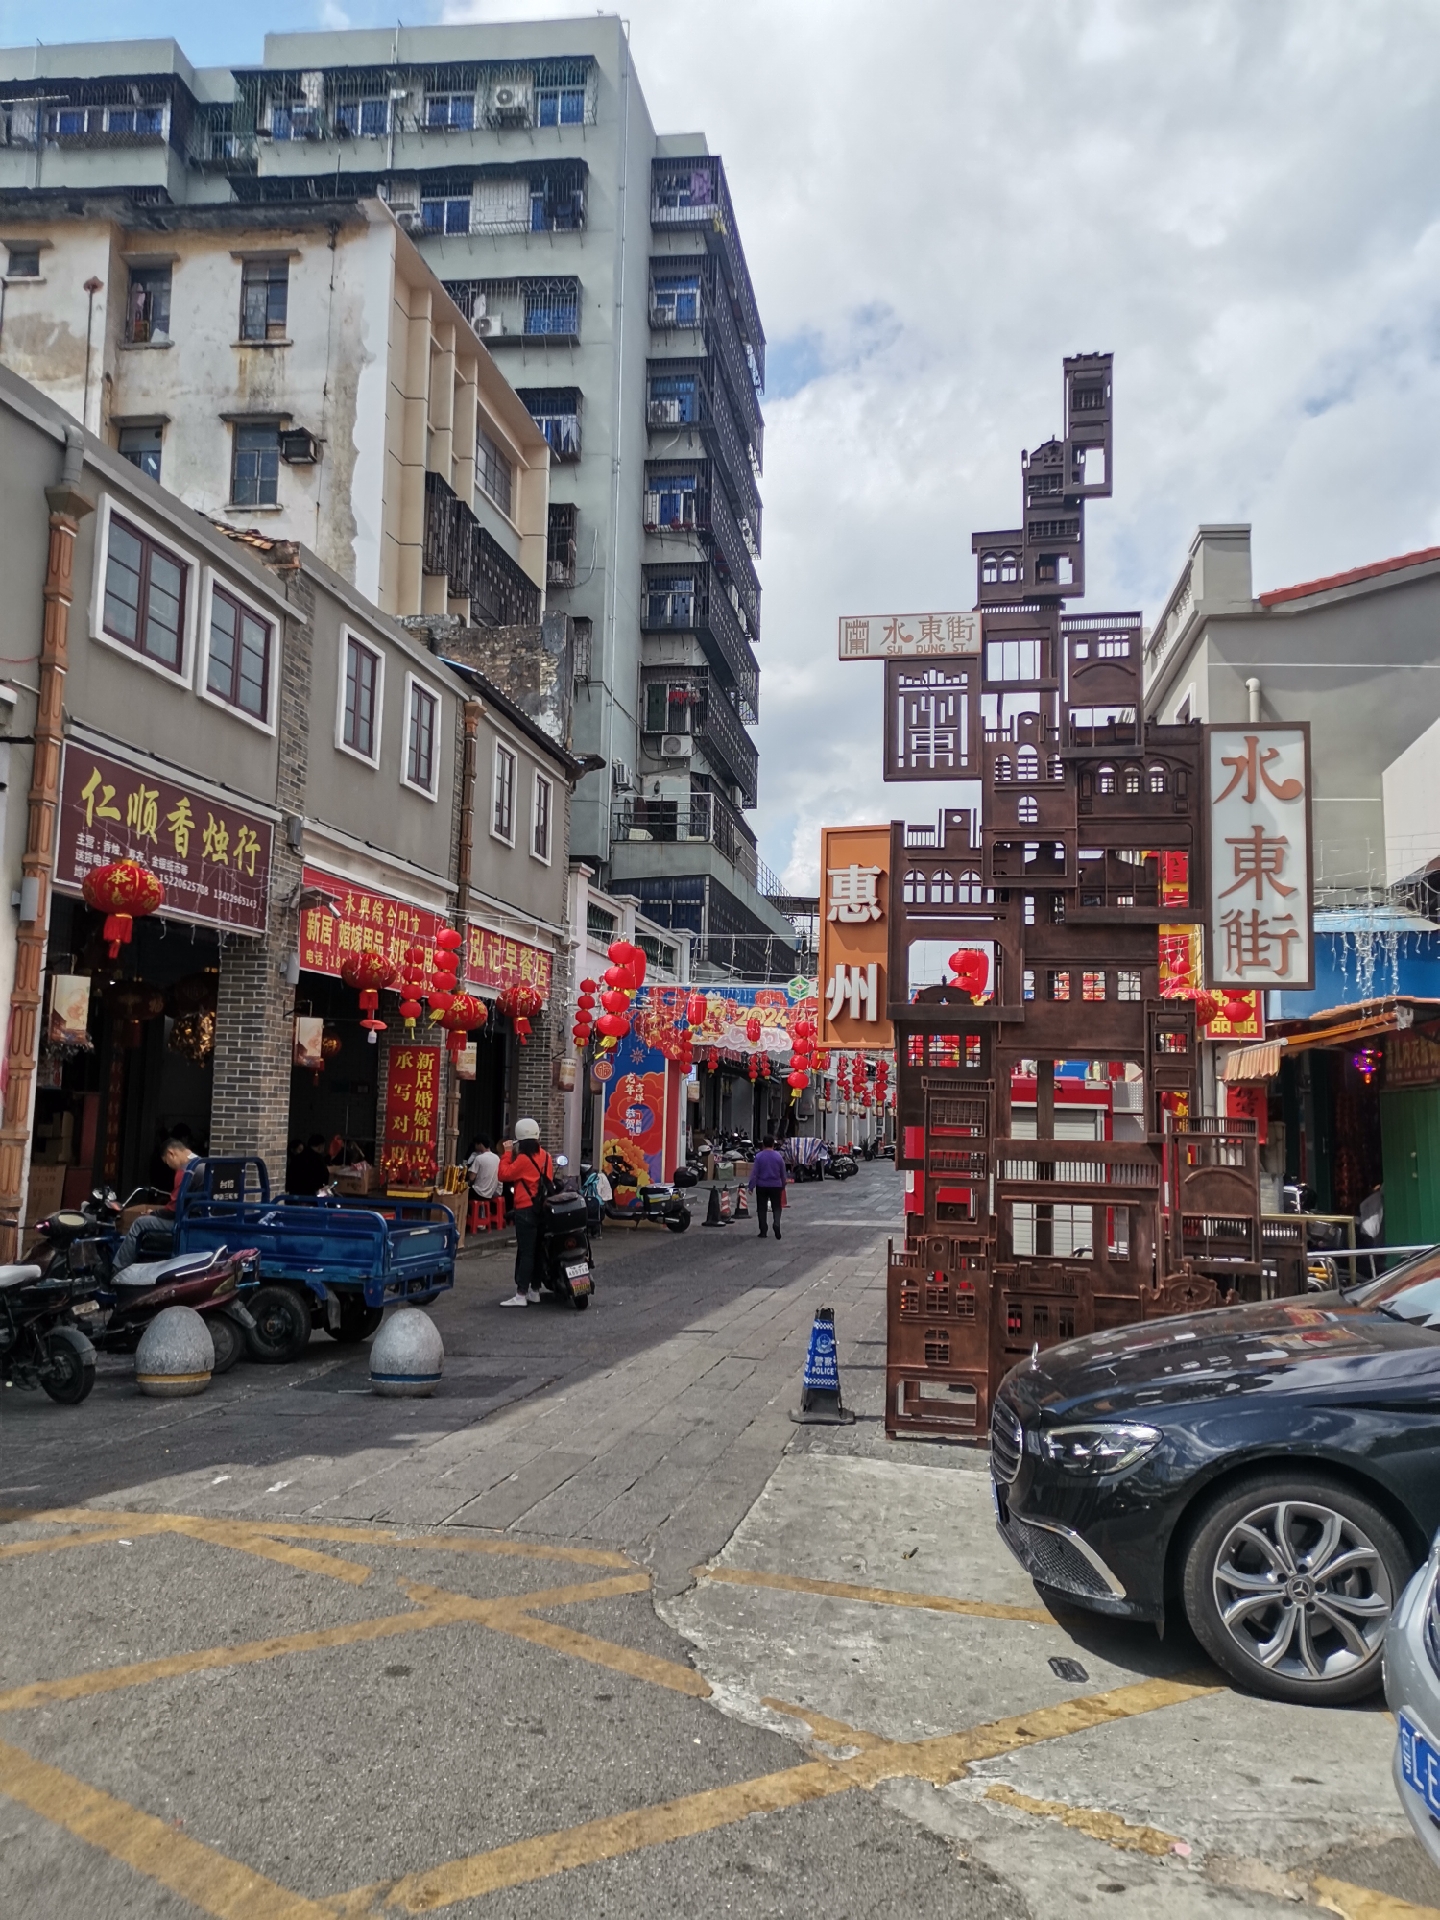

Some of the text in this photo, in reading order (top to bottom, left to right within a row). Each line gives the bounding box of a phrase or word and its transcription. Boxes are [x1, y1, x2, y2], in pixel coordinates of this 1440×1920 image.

[880, 615, 976, 646] 水東街
[886, 643, 969, 655] SUI DUNG ST.
[81, 766, 262, 878] 仁顺香烛行
[1212, 735, 1304, 976] 水東街
[306, 909, 333, 947] 新居
[826, 864, 883, 1022] 惠州
[735, 1006, 790, 1027] 2024
[413, 1051, 435, 1165] 新居婚嫁用品
[811, 1366, 835, 1376] POLICE
